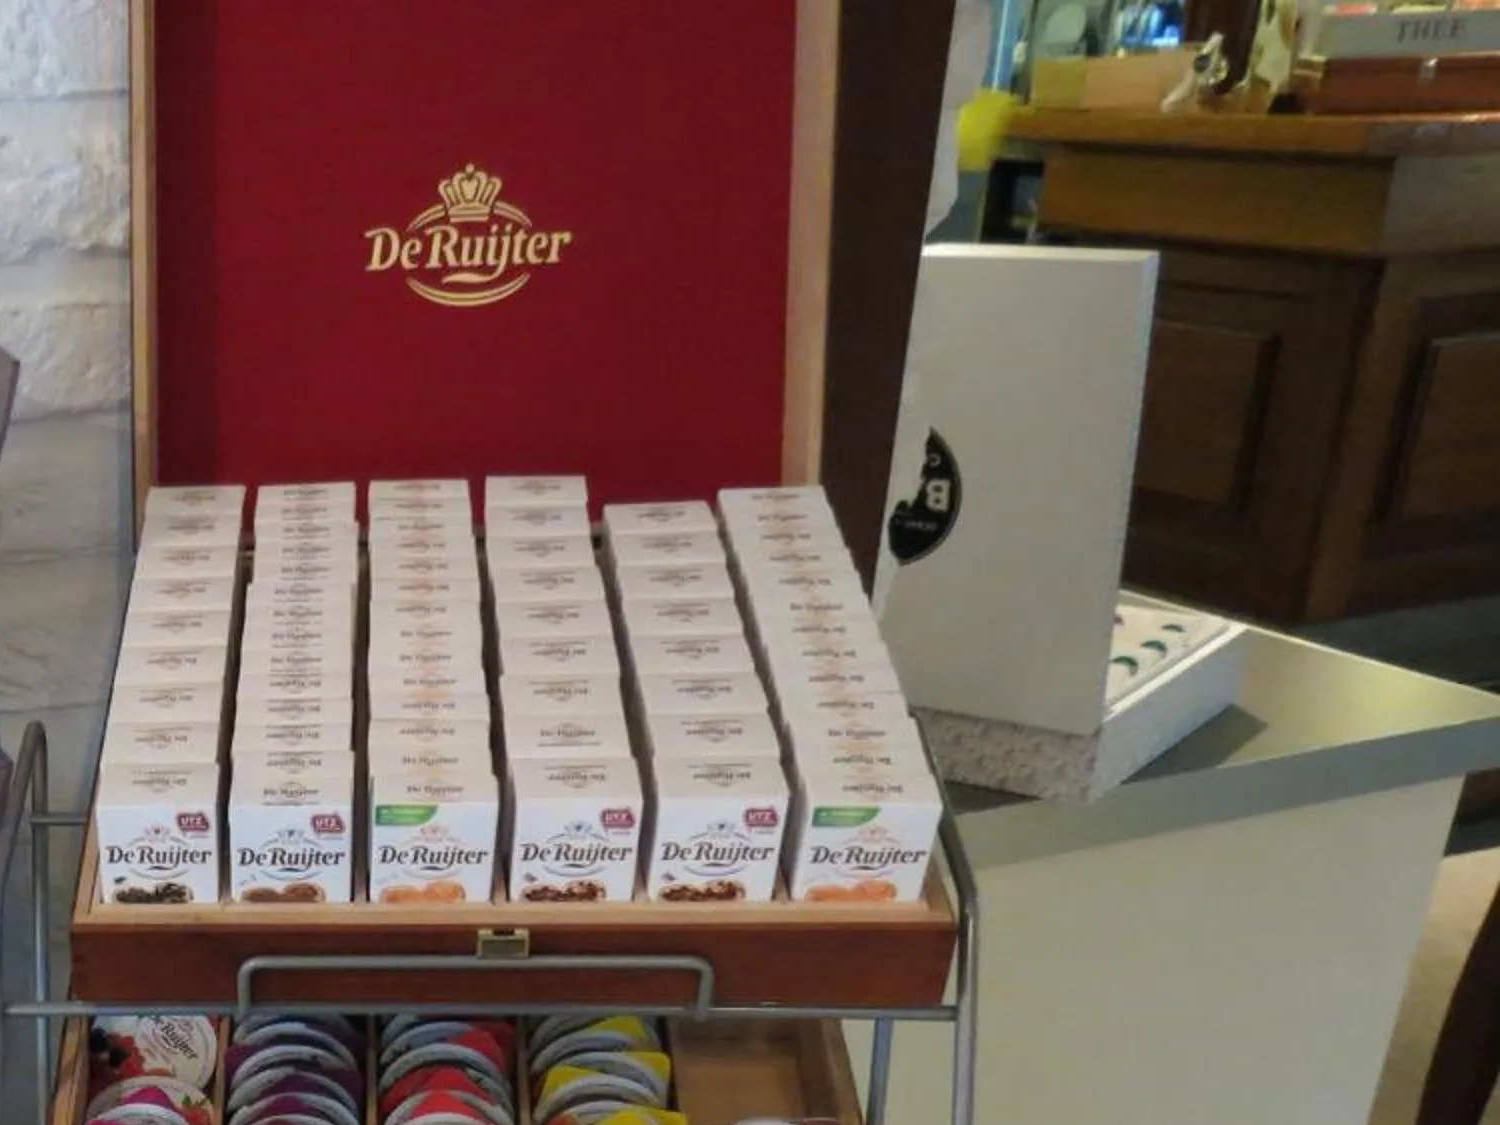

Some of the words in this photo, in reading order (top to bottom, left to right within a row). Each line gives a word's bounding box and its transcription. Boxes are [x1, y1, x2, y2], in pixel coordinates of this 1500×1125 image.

[1394, 17, 1467, 43] THEE
[423, 222, 574, 284] Ruijter
[136, 844, 213, 871] Ruijter
[269, 846, 346, 873] Ruijter
[410, 844, 489, 870] Ruijter
[553, 841, 633, 869] Ruijter
[693, 840, 775, 868] Ruijter
[845, 844, 928, 871] Ruijter
